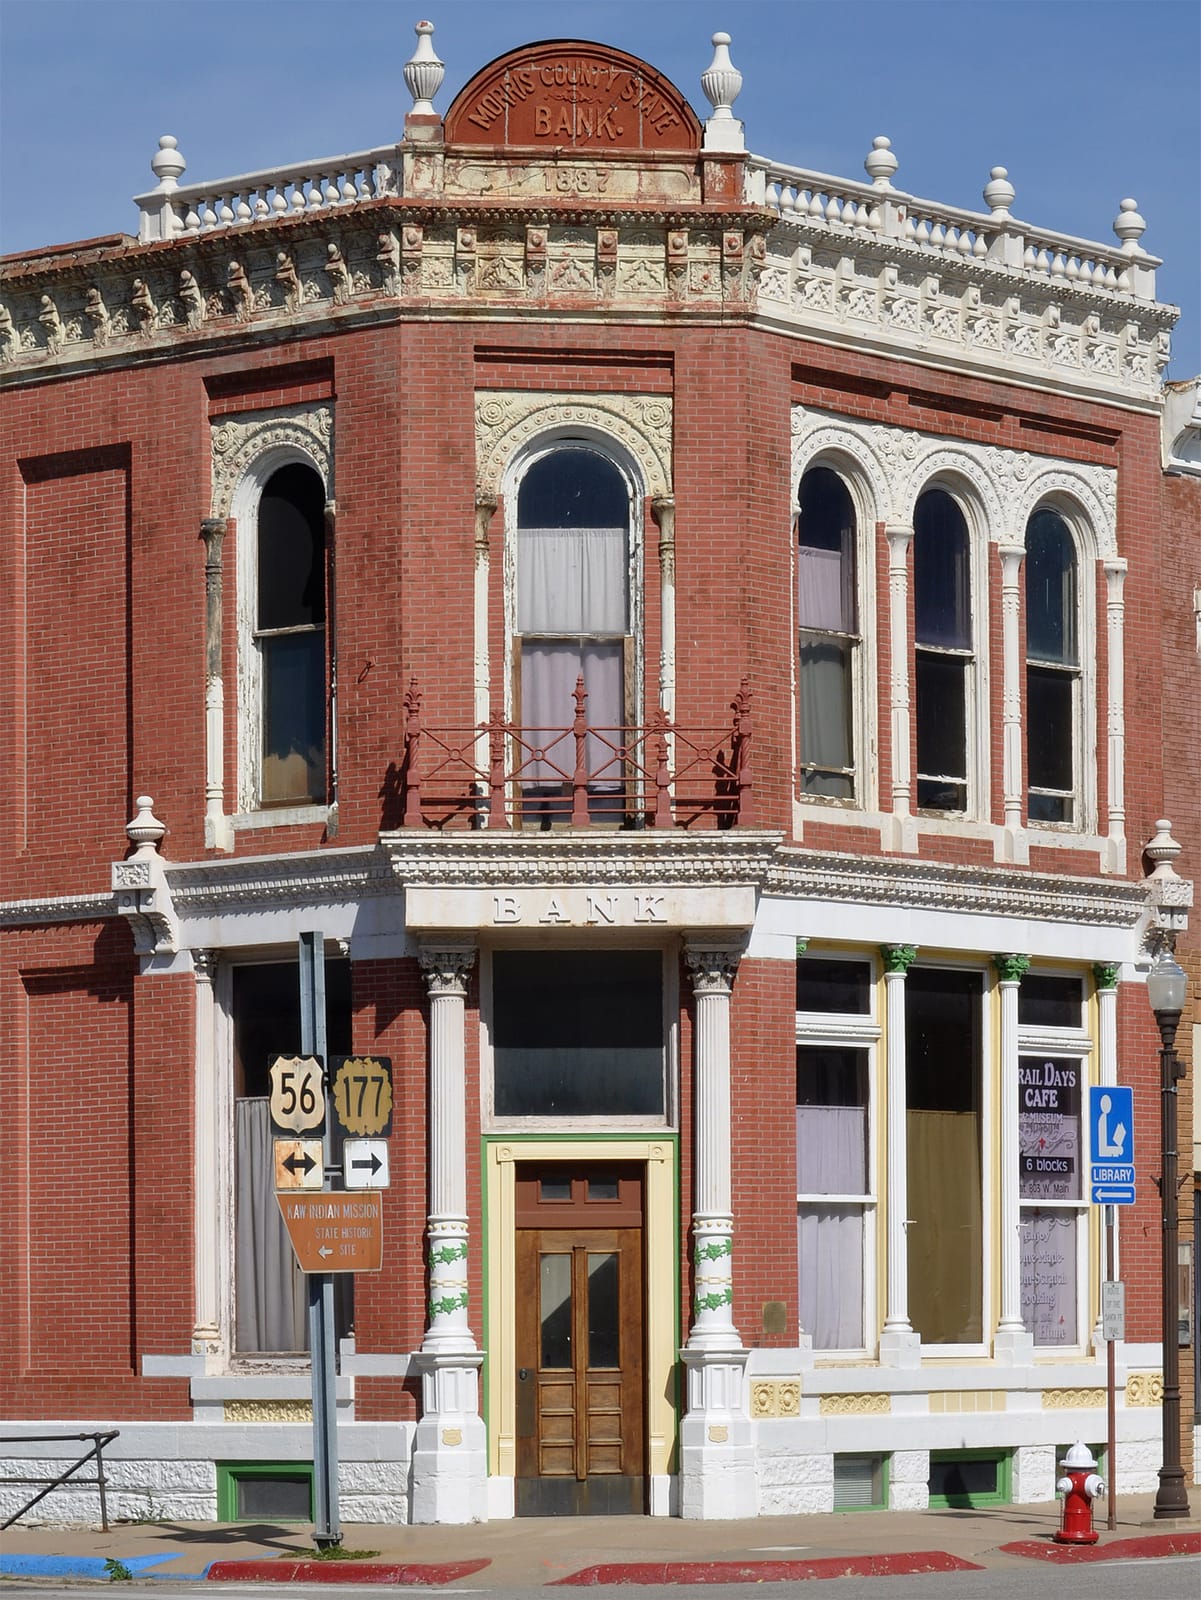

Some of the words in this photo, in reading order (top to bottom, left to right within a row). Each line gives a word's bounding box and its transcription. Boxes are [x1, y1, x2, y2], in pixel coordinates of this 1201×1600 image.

[468, 72, 536, 131] MORRIS
[539, 60, 622, 93] COUNTY
[620, 77, 680, 136] STATE
[542, 168, 611, 193] 1887
[493, 895, 668, 924] BANK
[1018, 1068, 1042, 1086] RAIL
[281, 1072, 316, 1115] 56
[343, 1076, 384, 1118] 177
[1025, 1088, 1058, 1108] CAFE
[1030, 1112, 1064, 1124] MUSEUM
[1026, 1158, 1033, 1171] 6
[1036, 1159, 1068, 1172] blocks
[1093, 1168, 1132, 1182] LIBRARY
[1053, 1183, 1070, 1194] Main
[287, 1203, 307, 1220] KAW
[309, 1203, 340, 1220] INDIAN
[343, 1203, 378, 1219] MISSION
[315, 1226, 339, 1240] STATE
[341, 1226, 374, 1239] HISTORIC
[340, 1244, 357, 1256] SITE
